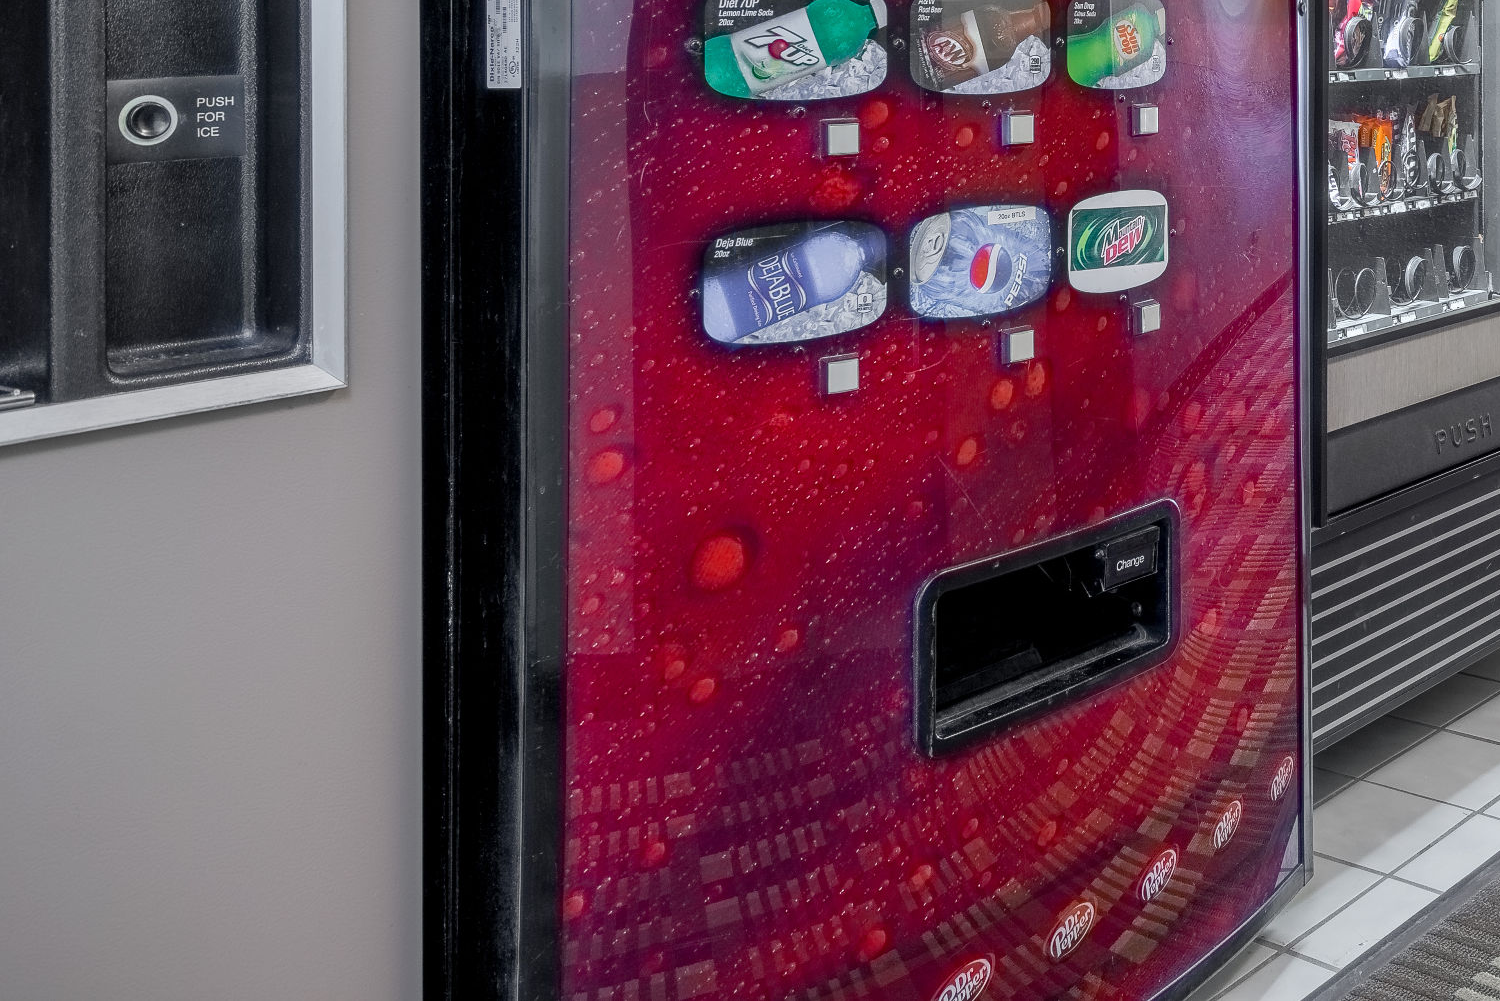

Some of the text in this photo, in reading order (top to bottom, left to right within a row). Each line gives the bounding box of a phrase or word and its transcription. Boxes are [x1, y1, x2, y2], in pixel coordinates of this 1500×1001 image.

[719, 8, 774, 17] Lemon Lime Soda
[931, 6, 943, 14] Beer
[197, 96, 235, 107] PUSH
[197, 112, 225, 122] FOR
[197, 127, 220, 137] ICE
[1011, 211, 1026, 219] BTLS
[716, 237, 753, 249] Deja Blue
[714, 250, 730, 258] 20oz
[1004, 252, 1028, 307] PEPSI
[1433, 411, 1494, 454] PUSH
[1116, 554, 1145, 572] Change
[1065, 910, 1080, 934] Dr
[1050, 908, 1090, 959] Pepper
[954, 967, 974, 993] Dr
